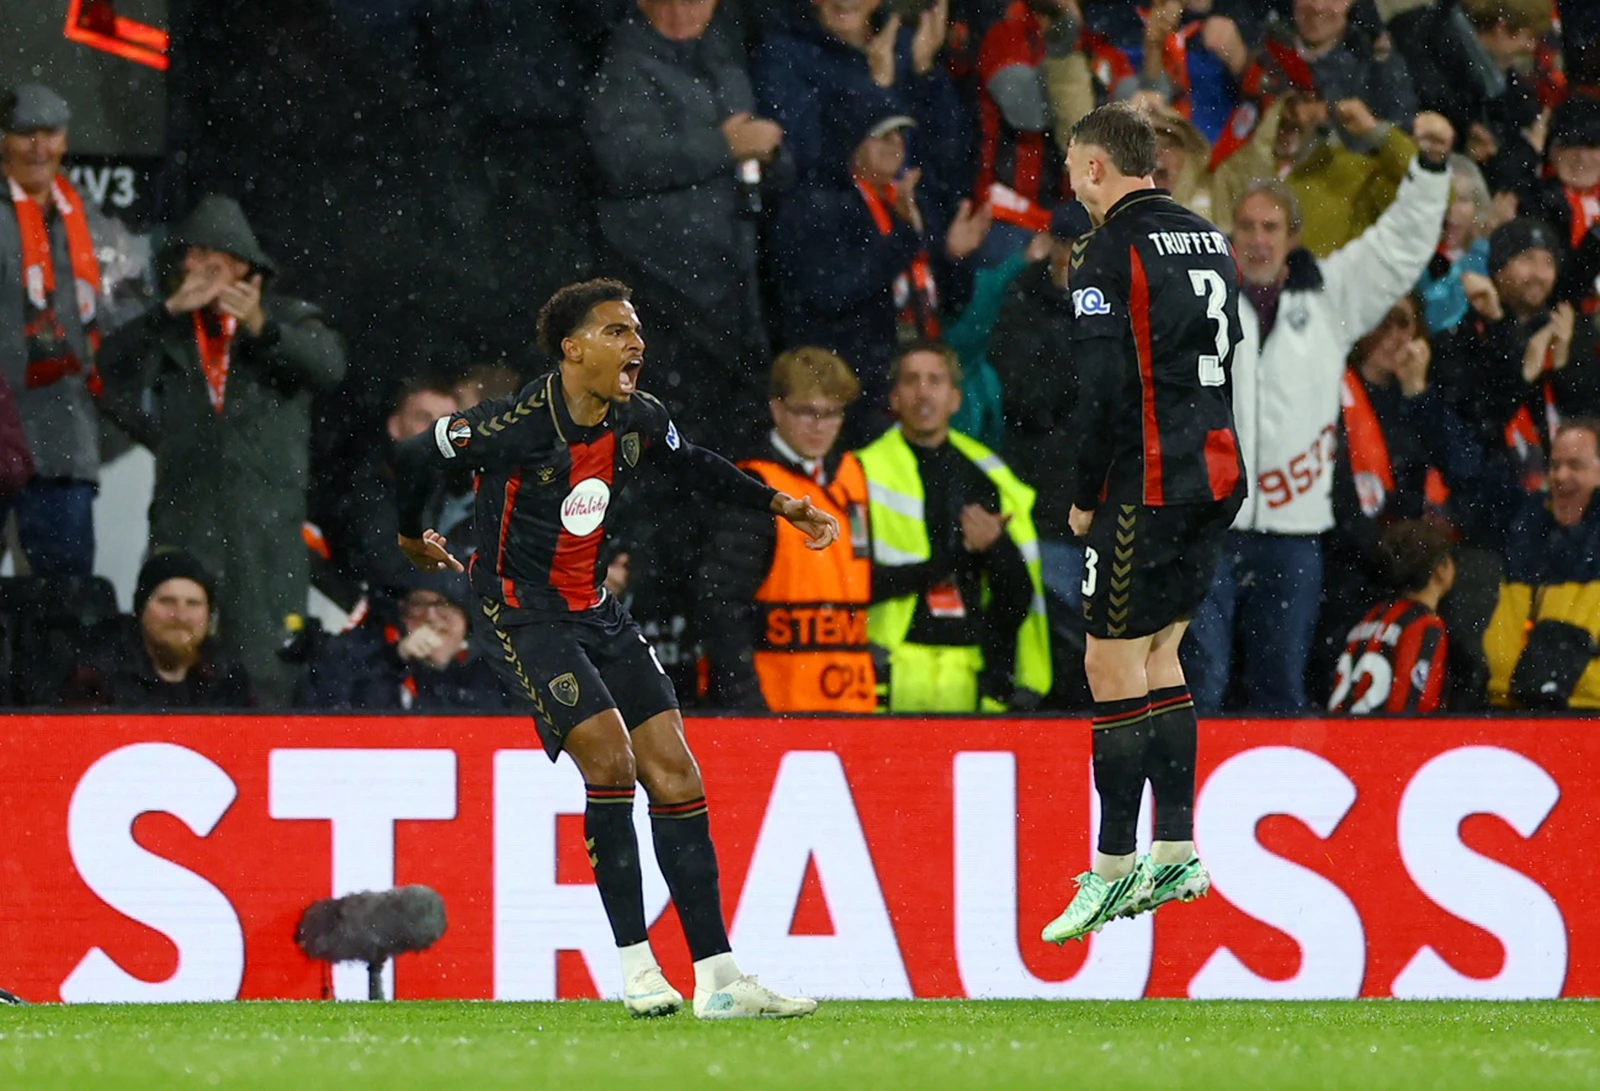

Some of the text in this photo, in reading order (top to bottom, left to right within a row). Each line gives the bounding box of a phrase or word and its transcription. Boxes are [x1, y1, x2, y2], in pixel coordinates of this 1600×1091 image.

[70, 167, 135, 208] V3
[1187, 269, 1229, 387] 3
[564, 493, 607, 518] Vitality
[1081, 546, 1099, 597] 3
[60, 742, 1567, 1000] STRAUSS
